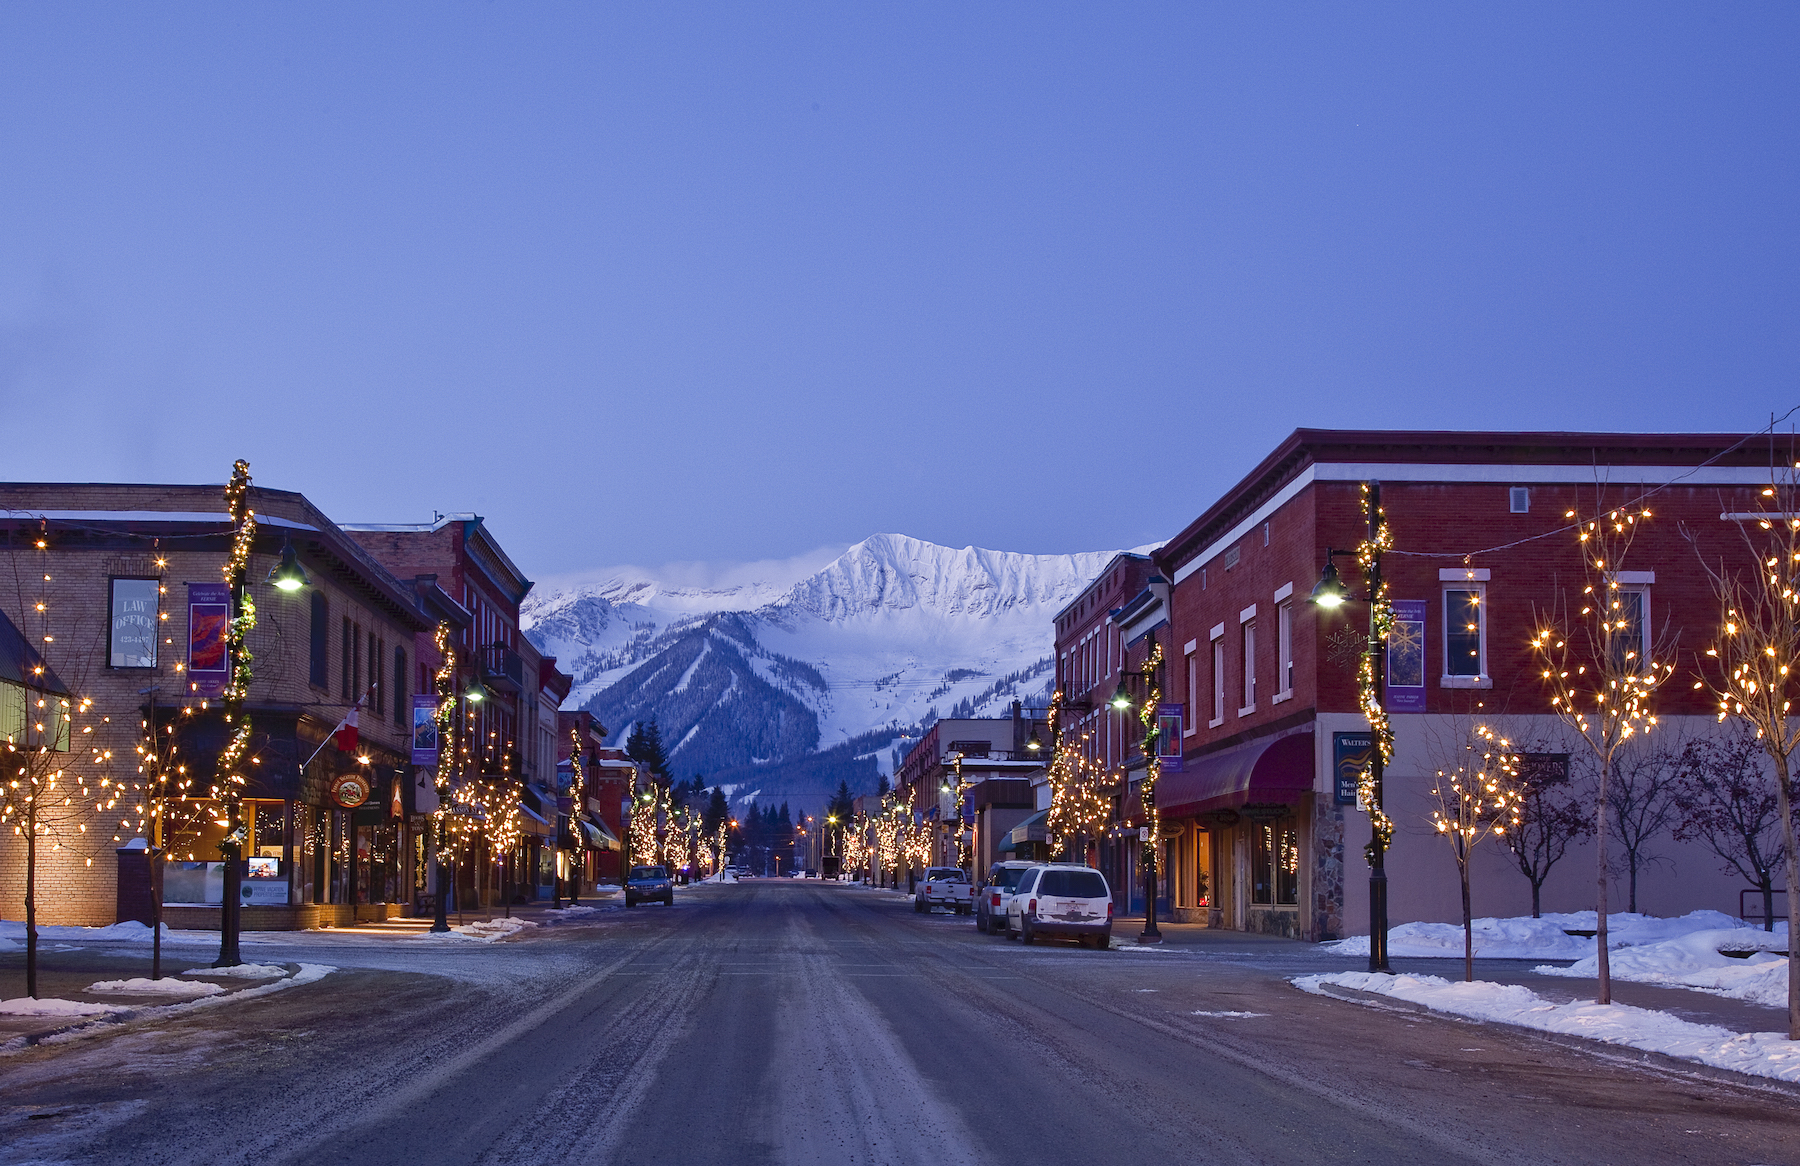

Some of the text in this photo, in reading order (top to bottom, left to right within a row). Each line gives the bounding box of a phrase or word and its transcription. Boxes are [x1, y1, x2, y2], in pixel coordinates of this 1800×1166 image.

[123, 600, 148, 613] LAW
[116, 615, 155, 631] OFFICE
[1341, 738, 1372, 747] WALTER'S
[1341, 780, 1360, 788] Men's
[411, 814, 425, 822] BOOKS
